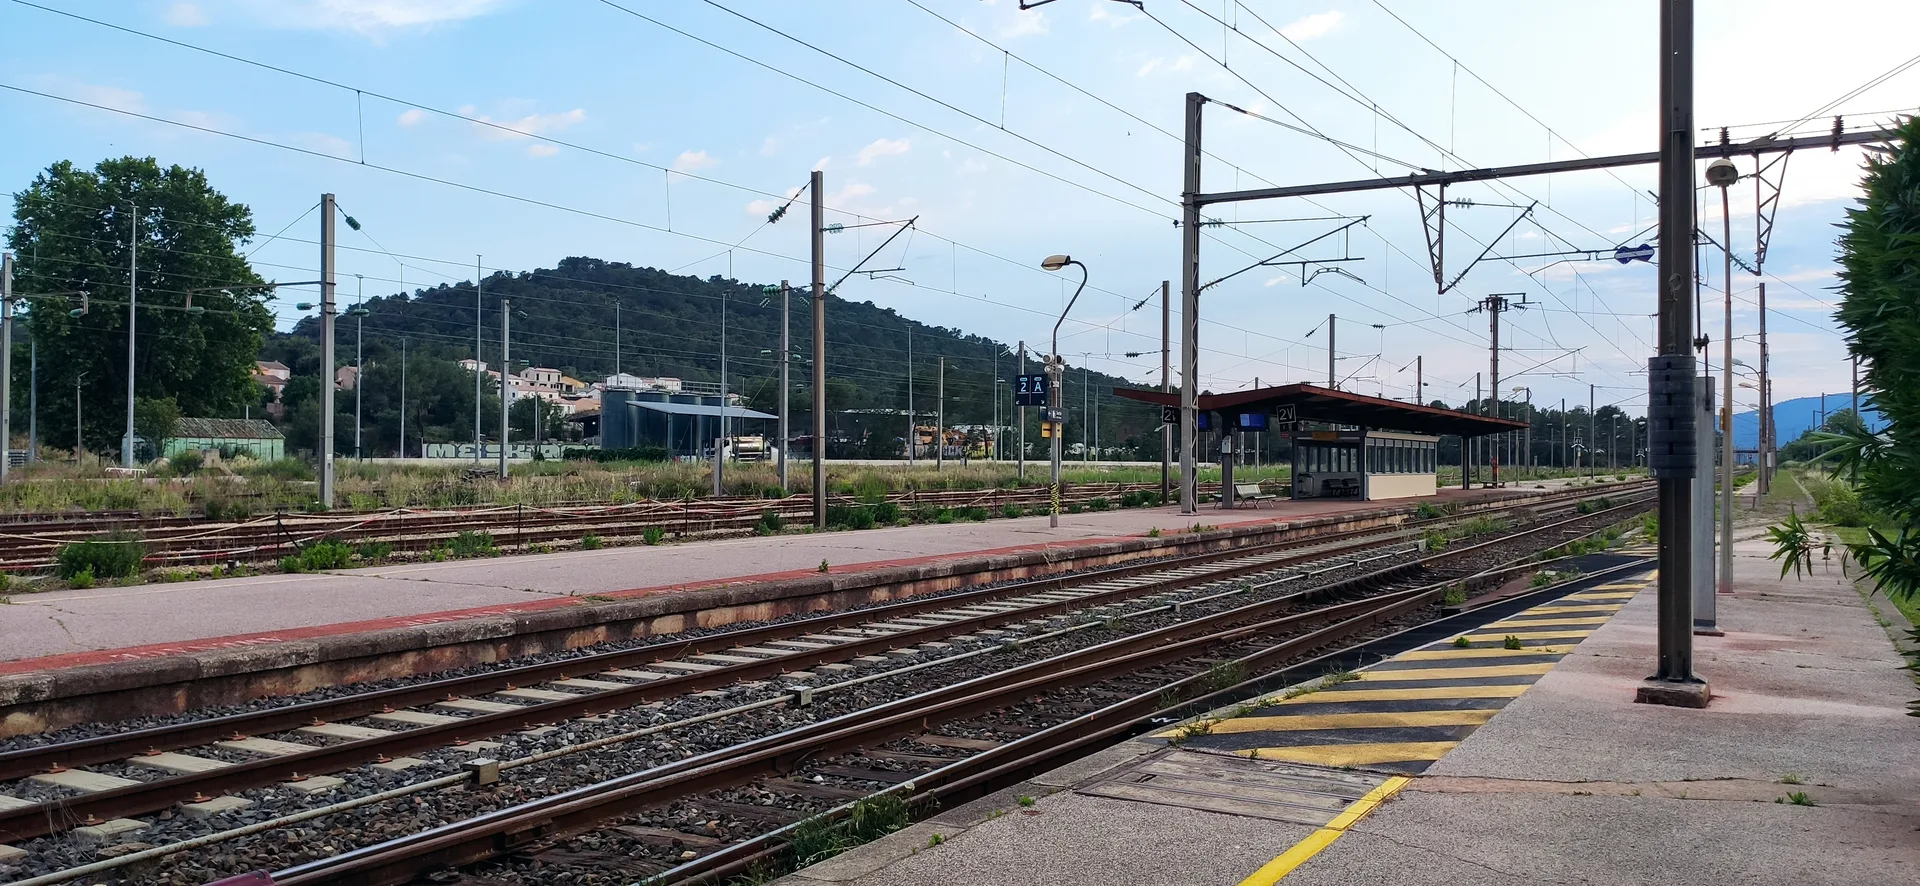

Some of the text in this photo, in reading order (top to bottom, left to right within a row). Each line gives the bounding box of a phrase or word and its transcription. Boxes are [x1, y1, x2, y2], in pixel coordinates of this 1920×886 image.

[1020, 382, 1026, 392] 2
[1034, 382, 1042, 392] A
[1279, 407, 1293, 421] 2V
